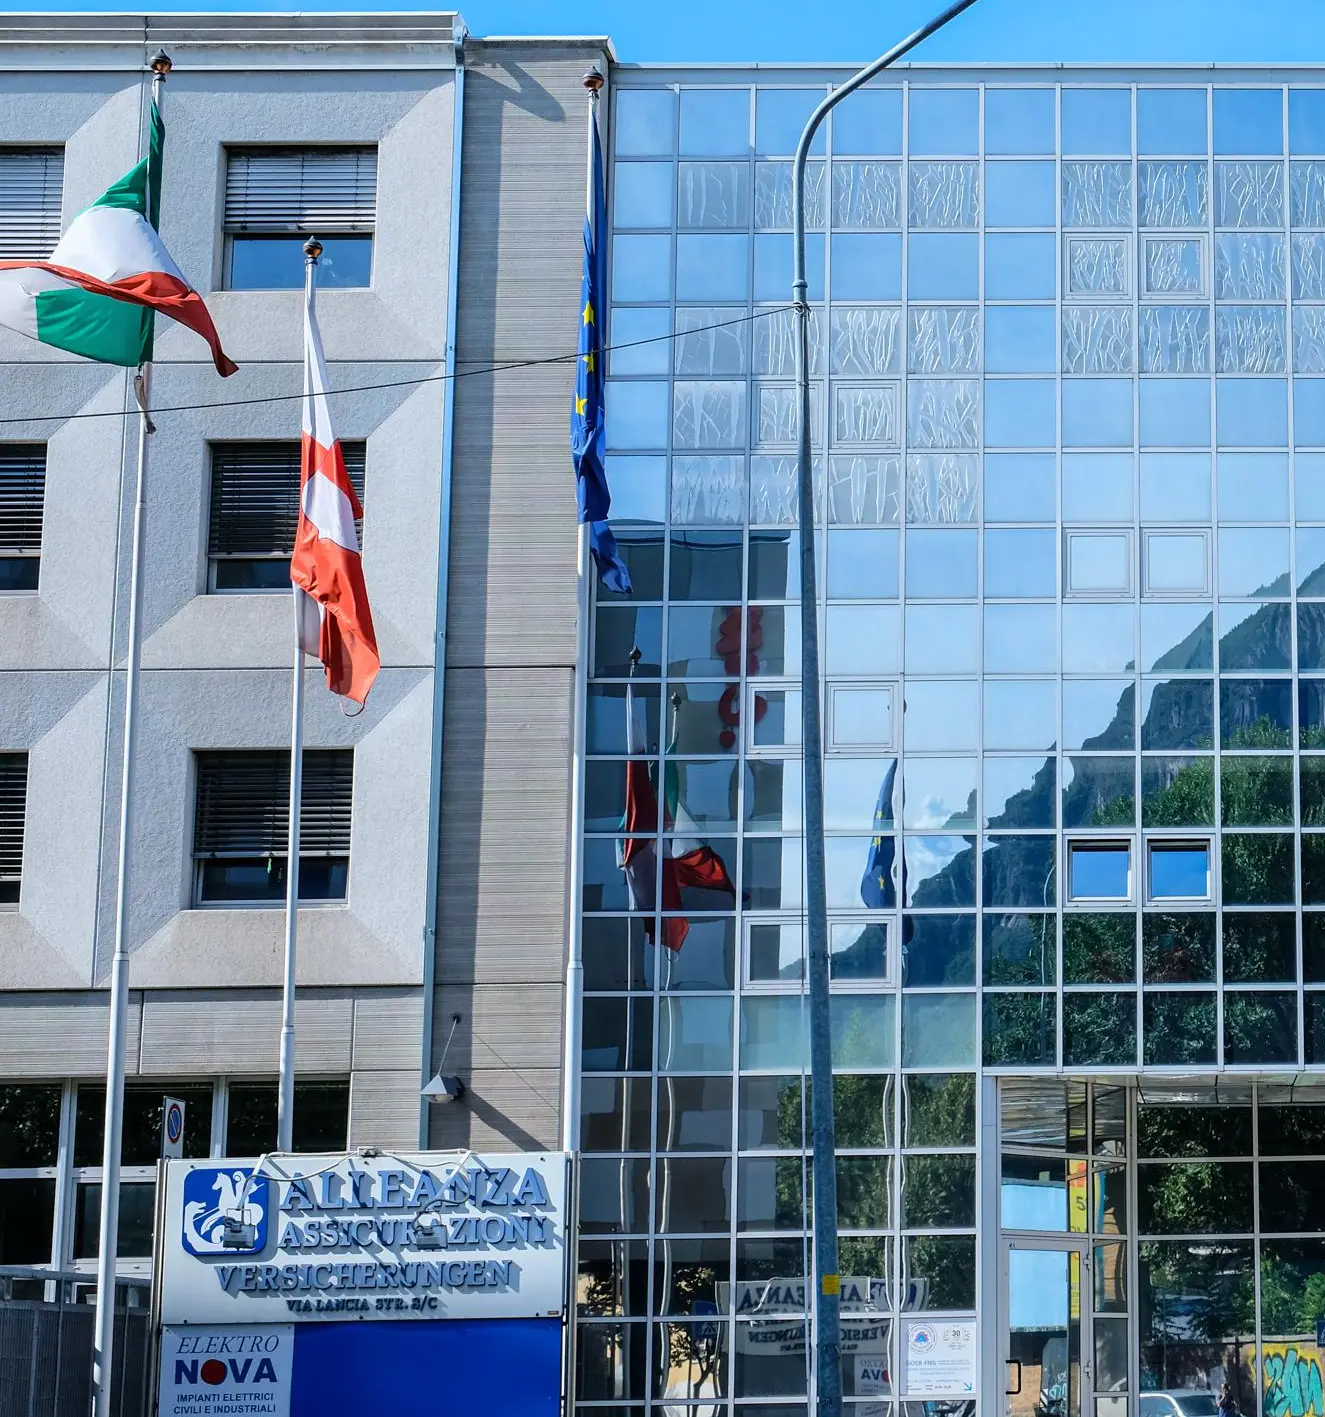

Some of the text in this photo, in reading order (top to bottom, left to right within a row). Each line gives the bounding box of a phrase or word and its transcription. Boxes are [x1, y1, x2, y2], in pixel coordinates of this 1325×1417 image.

[279, 1167, 547, 1210] ALLEANZA
[278, 1215, 547, 1249] ASSICURZIONI
[214, 1260, 512, 1292] VERSICHERUNGEN
[286, 1299, 312, 1312] VIA
[315, 1298, 369, 1312] LANCIA
[176, 1334, 279, 1354] ELEKTRO
[174, 1358, 278, 1385] NOVA
[177, 1392, 274, 1403] IMPIANTI ELETTRICI
[173, 1404, 276, 1415] CIVILI E INDUSTRIALI
